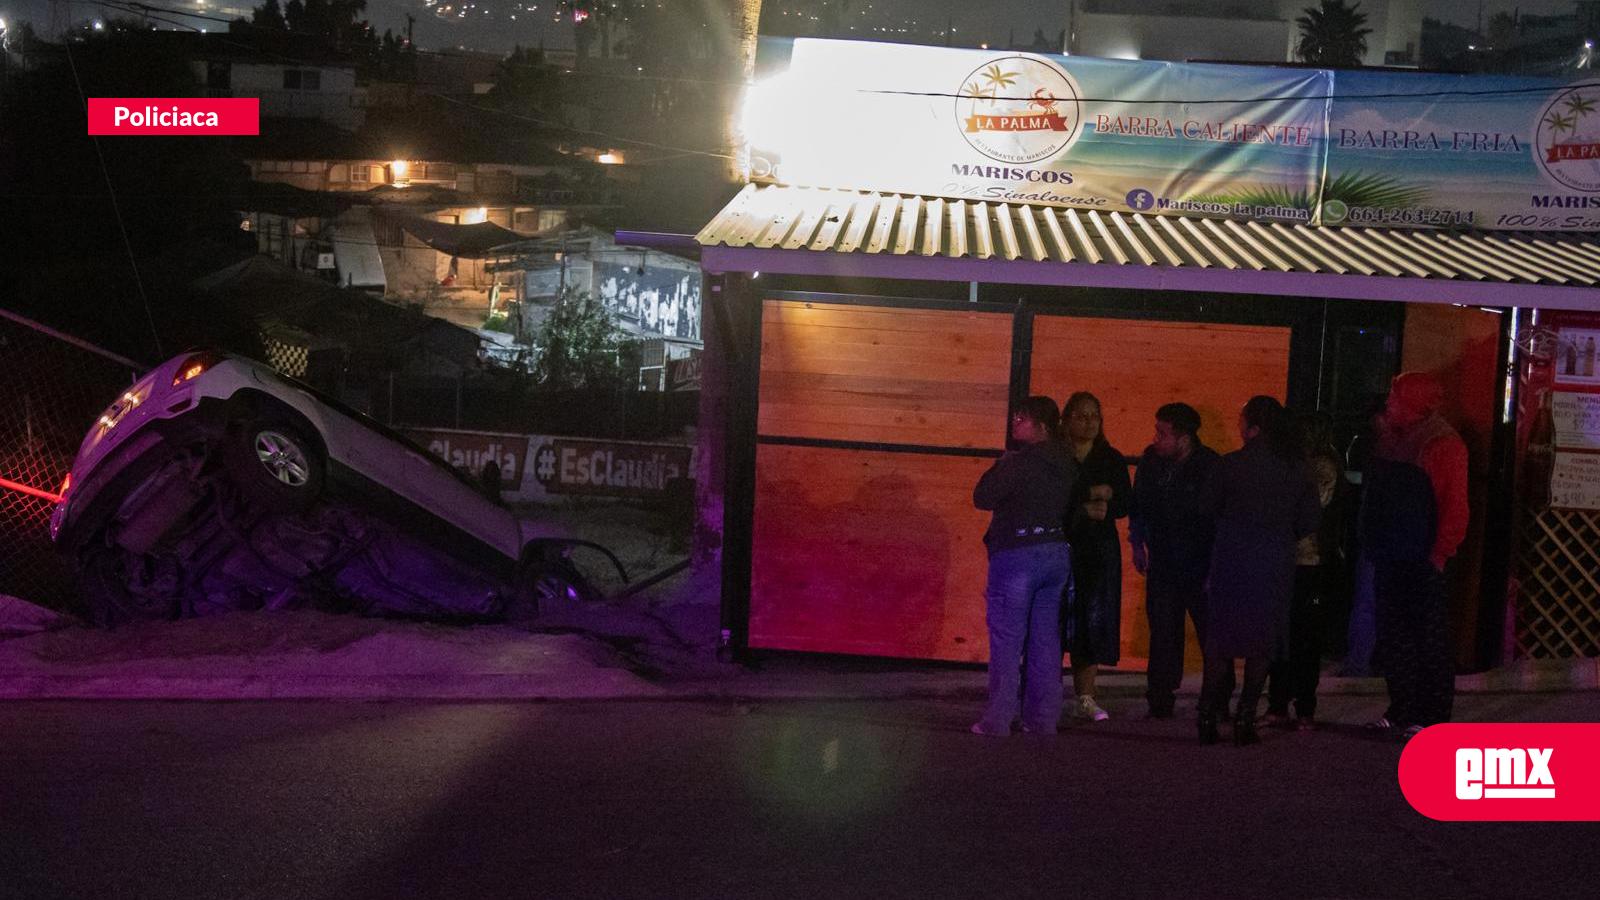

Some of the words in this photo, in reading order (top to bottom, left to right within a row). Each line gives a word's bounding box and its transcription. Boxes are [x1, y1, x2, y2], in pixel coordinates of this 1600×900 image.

[976, 117, 995, 129] LA
[1001, 117, 1051, 129] PALMA
[1095, 114, 1176, 138] BARRA
[1183, 120, 1312, 147] CALIENTE
[1338, 128, 1441, 150] BARRA
[1451, 132, 1522, 151] FRIA
[1556, 146, 1573, 158] LA
[951, 163, 1074, 185] MARISCOS
[982, 186, 1107, 206] Sinaloense
[1531, 195, 1600, 209] MARIS
[1156, 198, 1230, 214] Mariscos
[1234, 202, 1251, 216] la
[1254, 205, 1309, 220] palma
[1350, 207, 1475, 224] 664-263-2714
[1496, 213, 1558, 228] 100%
